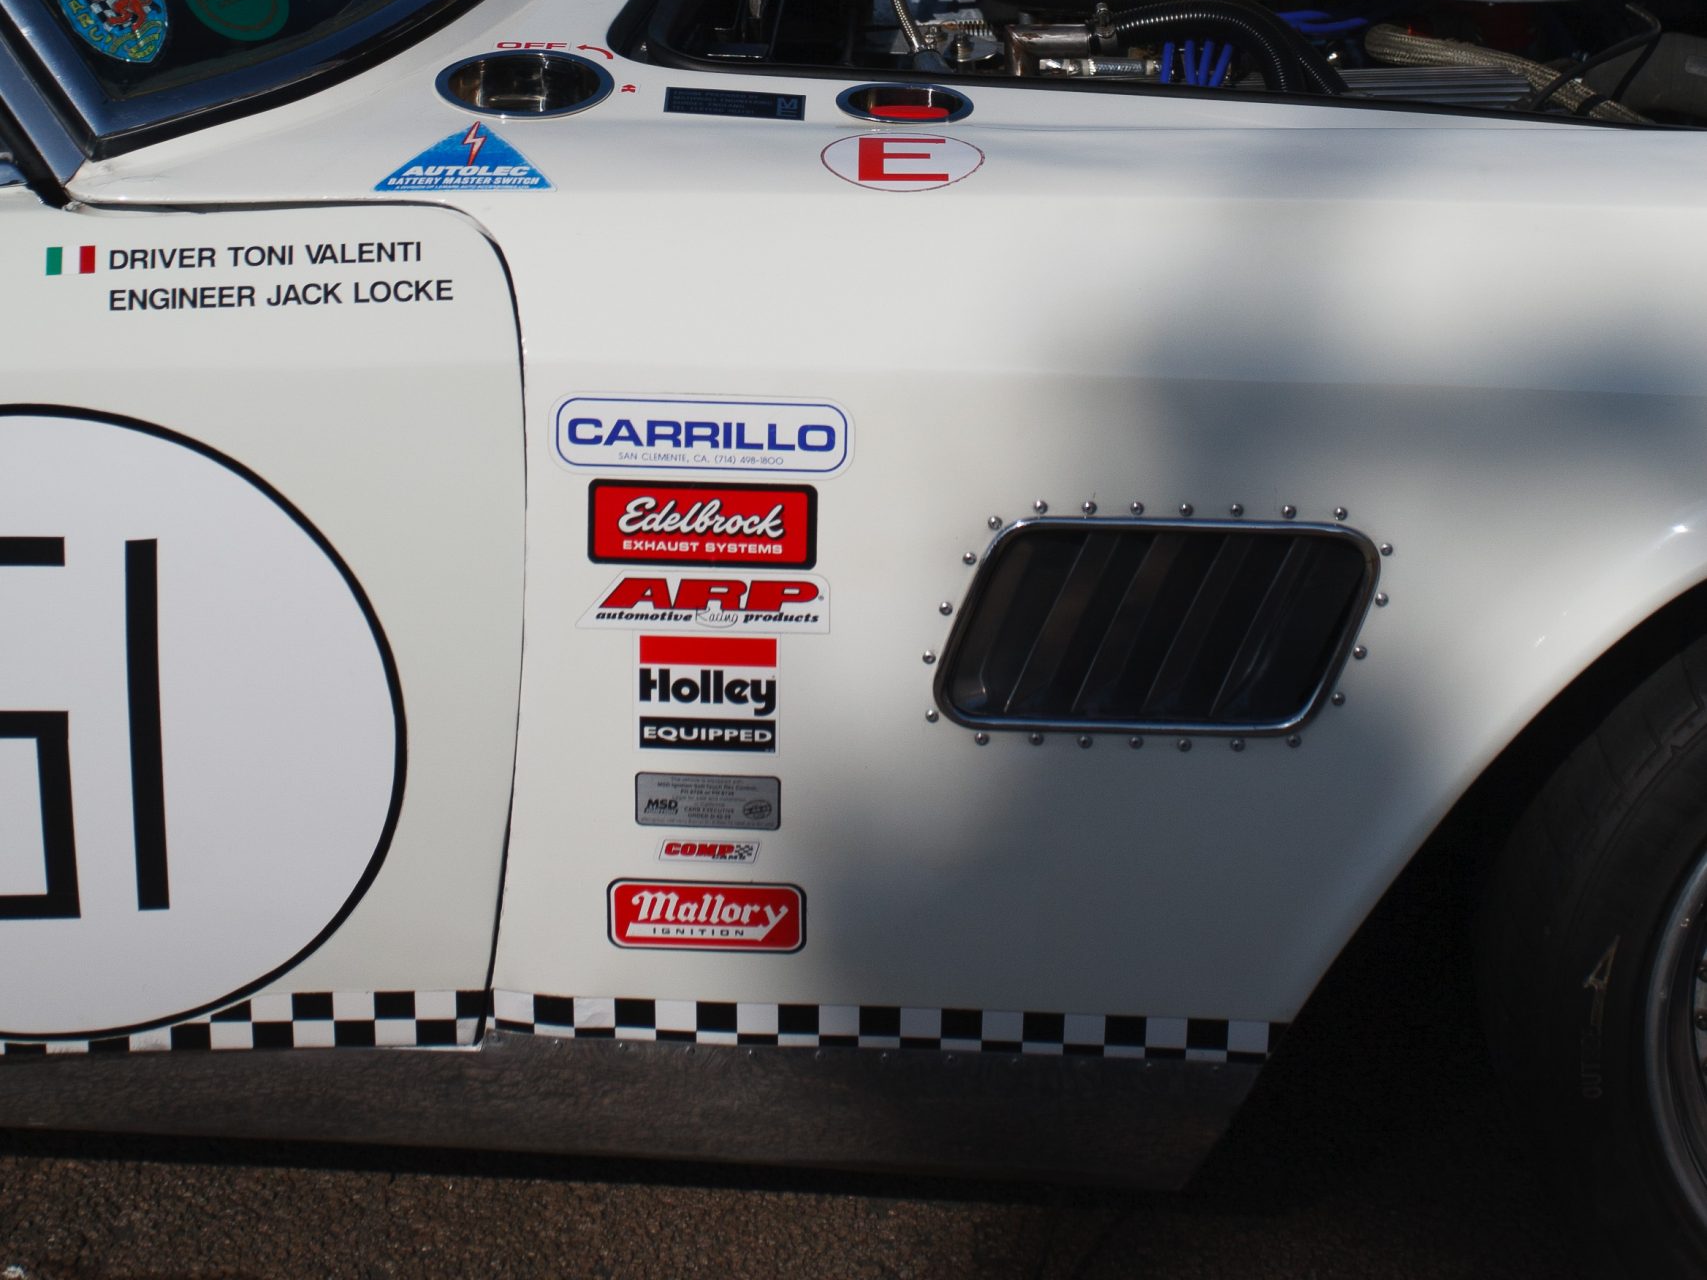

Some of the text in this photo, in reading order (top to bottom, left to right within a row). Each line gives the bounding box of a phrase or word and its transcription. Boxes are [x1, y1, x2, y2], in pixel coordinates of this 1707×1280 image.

[496, 41, 567, 50] OFF
[858, 138, 949, 181] E
[401, 165, 531, 177] AUTOLEC
[387, 177, 540, 186] BATTERY MASTER SWITCH
[109, 241, 422, 271] DRIVER TONI VALENTI
[109, 279, 454, 311] ENGINEER JACK LOCKE
[567, 417, 836, 452] CARRILLO
[618, 452, 637, 461] SAN
[618, 496, 785, 539] Edelbrock
[623, 540, 782, 554] EXHAUST SYSTEMS
[599, 577, 820, 611] ARP
[595, 611, 693, 622] automotive
[743, 611, 819, 624] products
[639, 667, 777, 716] Holley
[643, 726, 773, 743] EQUIPPED
[647, 798, 678, 810] MSD
[664, 842, 735, 857] COMP
[631, 889, 789, 927] Mallory
[652, 926, 744, 937] IGNITION
